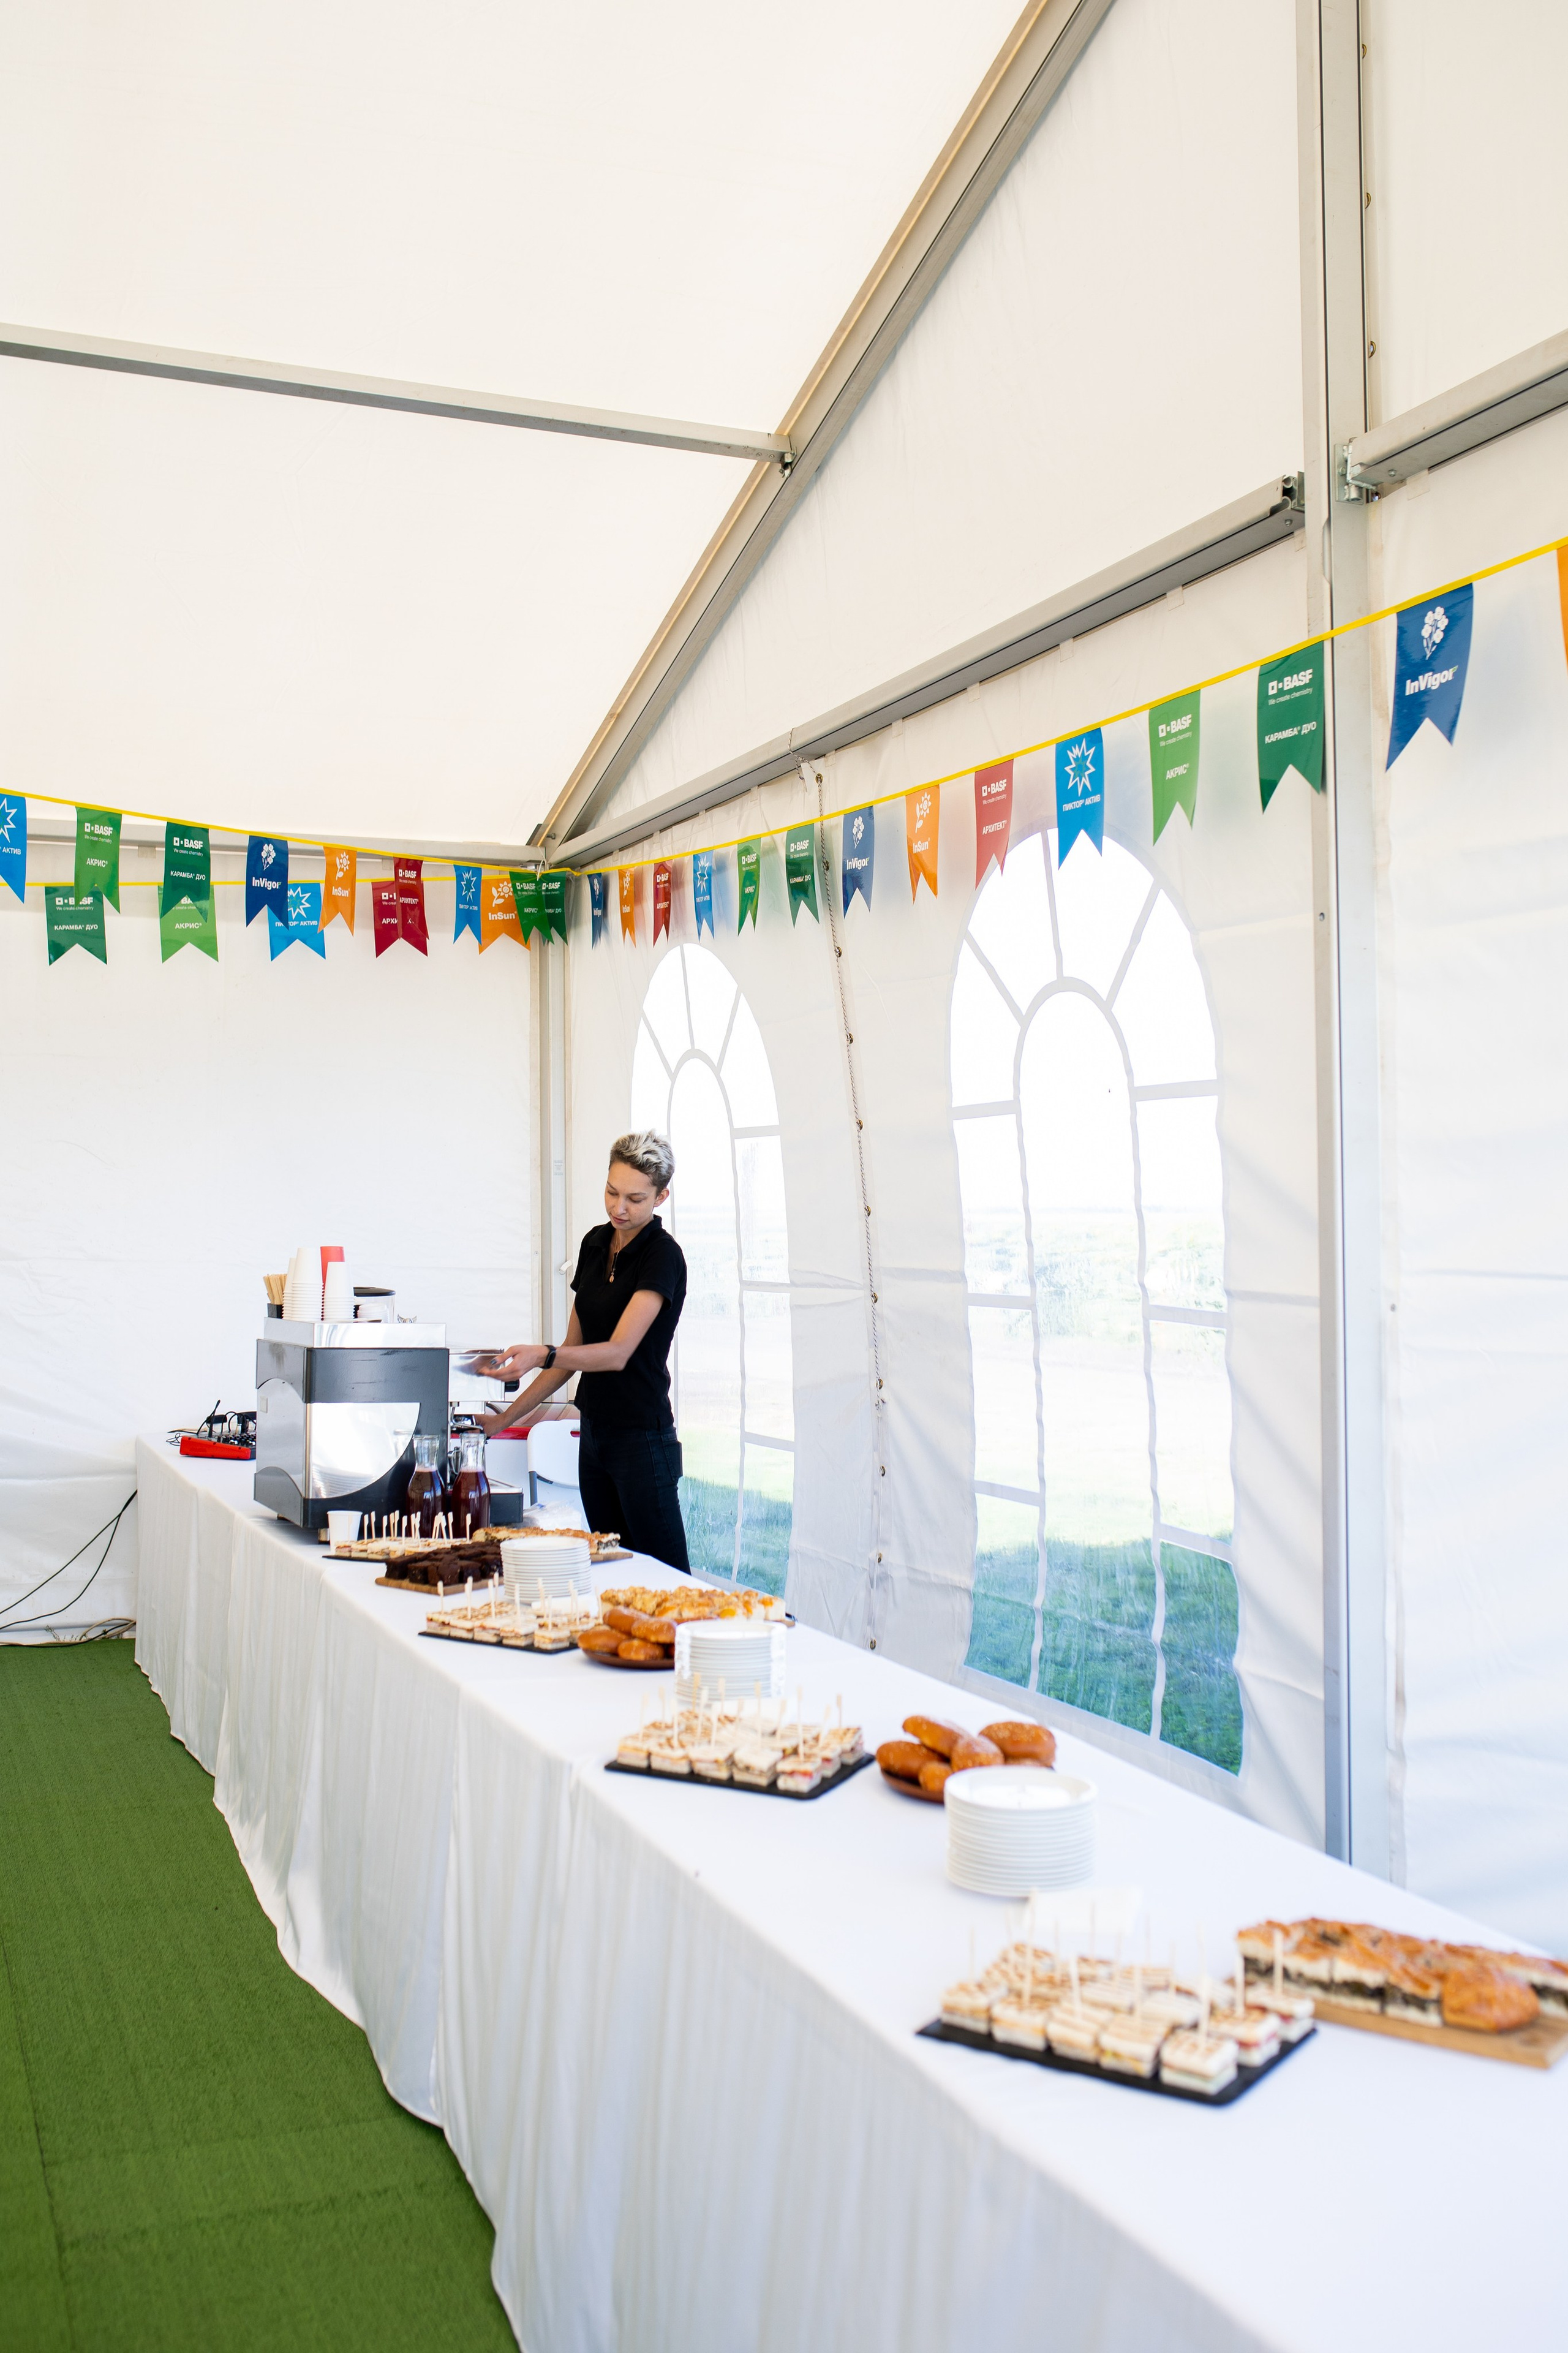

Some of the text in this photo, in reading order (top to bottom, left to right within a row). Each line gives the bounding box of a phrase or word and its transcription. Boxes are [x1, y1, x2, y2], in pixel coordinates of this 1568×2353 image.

[1283, 668, 1313, 691] BASF
[1404, 666, 1456, 696] InVigor
[1170, 714, 1192, 734] BASF
[1300, 721, 1317, 736] ДУО
[990, 779, 1007, 795] BASF
[1085, 795, 1101, 806] АКТИВ
[94, 824, 113, 836] BASF
[184, 838, 203, 850] BASF
[796, 839, 809, 851] BASF
[2, 847, 21, 855] АКТИВ
[747, 853, 757, 864] BASF
[846, 857, 869, 871] InVigor
[404, 869, 417, 879] BASF
[252, 877, 280, 890] InVigor
